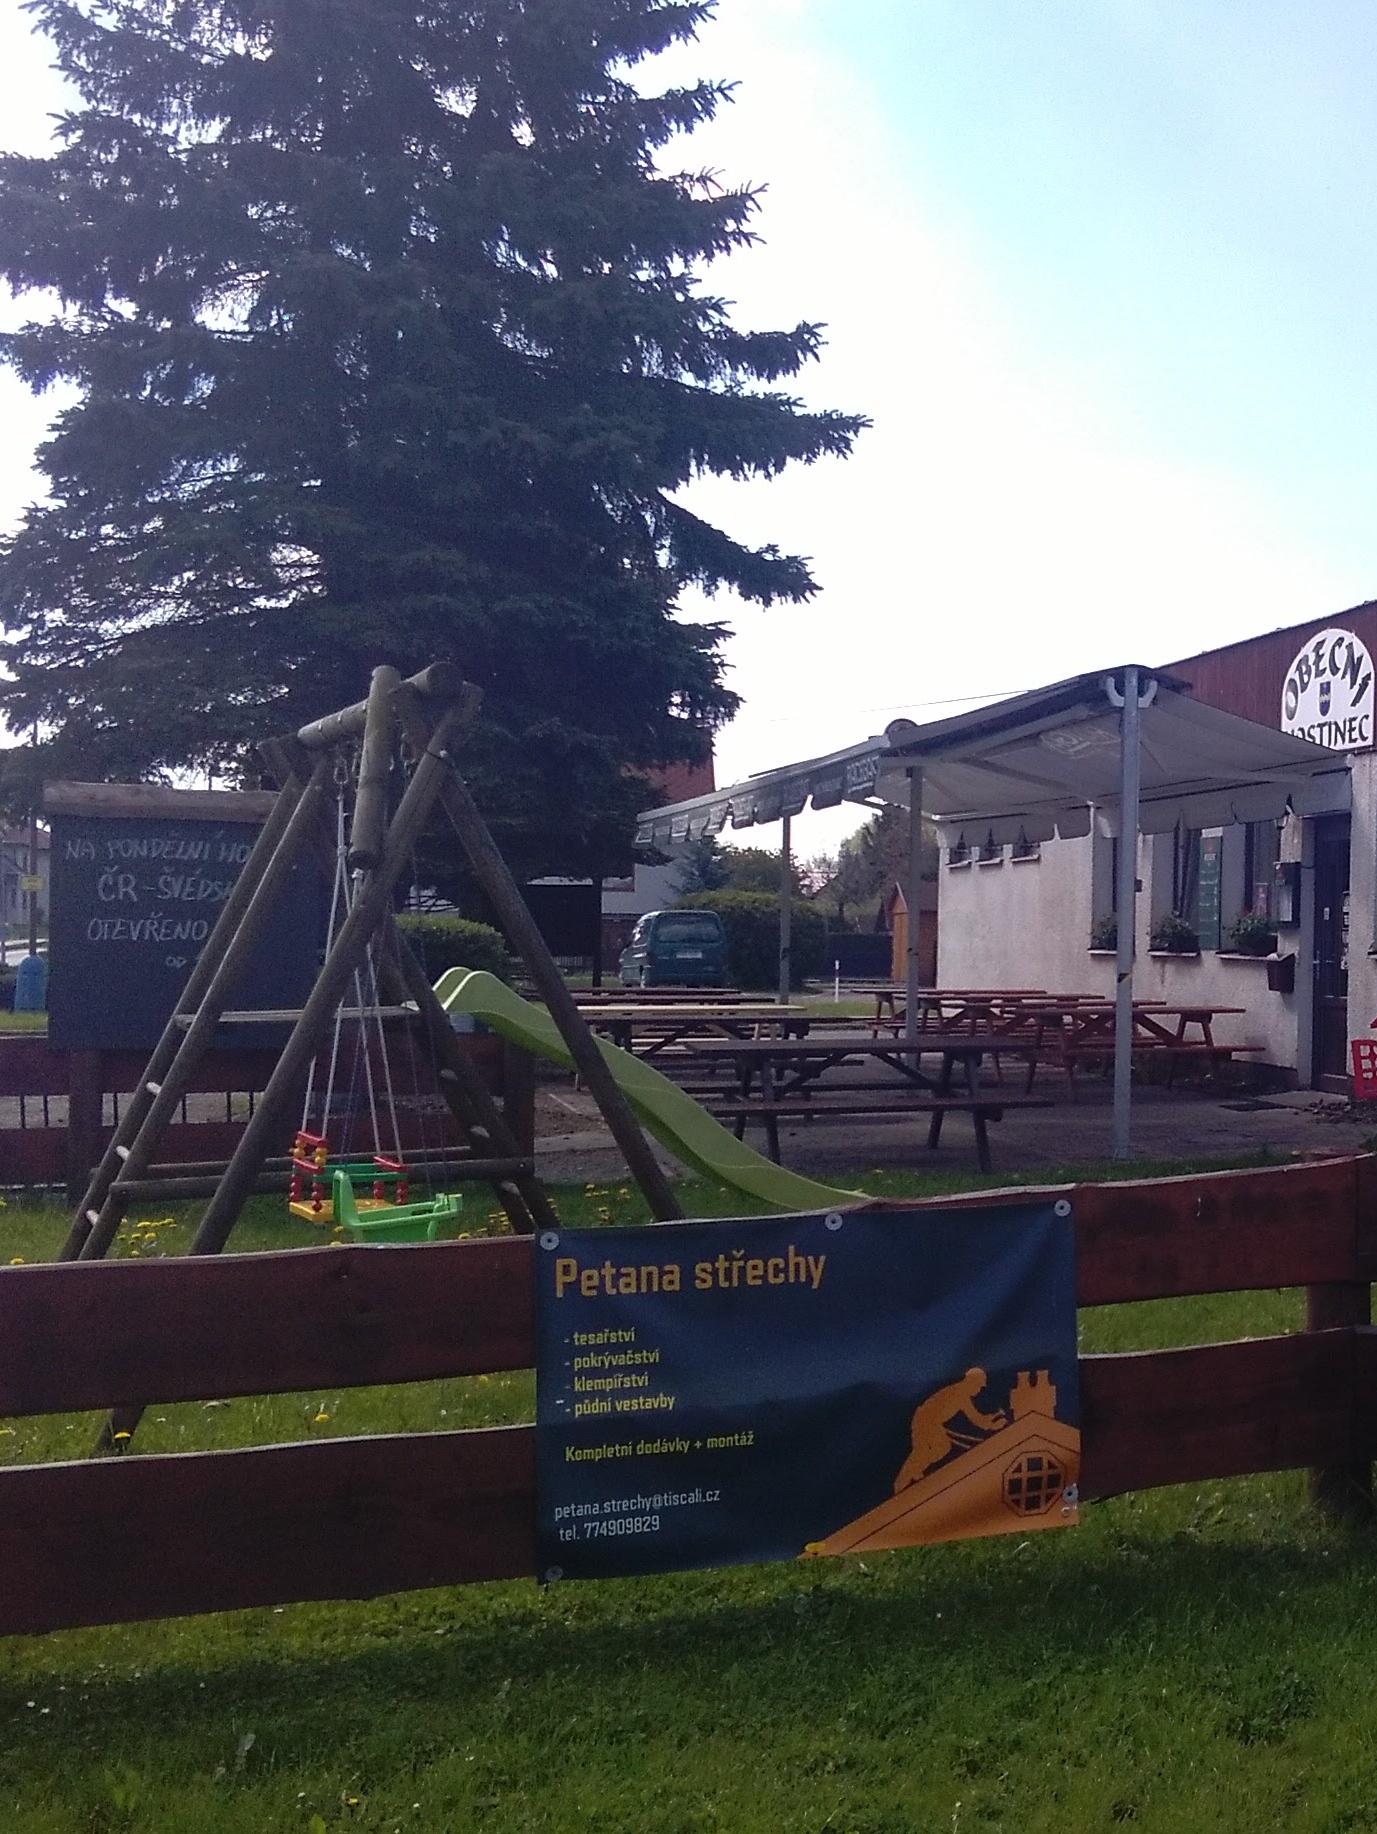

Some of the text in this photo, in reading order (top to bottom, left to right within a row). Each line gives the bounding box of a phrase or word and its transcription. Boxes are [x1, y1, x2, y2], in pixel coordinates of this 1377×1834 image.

[1285, 636, 1372, 721] OBECNÍ
[1291, 714, 1370, 748] STINEC
[65, 838, 95, 860] NA
[98, 865, 138, 901] ČR
[87, 912, 209, 942] OTEVŘENO
[556, 1245, 827, 1298] Petana střechy
[573, 1327, 635, 1345] tesařství
[574, 1349, 660, 1371] pokrývačství
[574, 1372, 649, 1392] klempířství
[575, 1397, 612, 1418] půdní
[615, 1392, 676, 1410] vestavby
[565, 1441, 632, 1462] Kompletní
[636, 1437, 690, 1456] dodávky
[706, 1431, 754, 1448] montáž
[554, 1487, 721, 1521] petana.strechy@tiscali.cz
[559, 1515, 660, 1541] tel. 774909829
